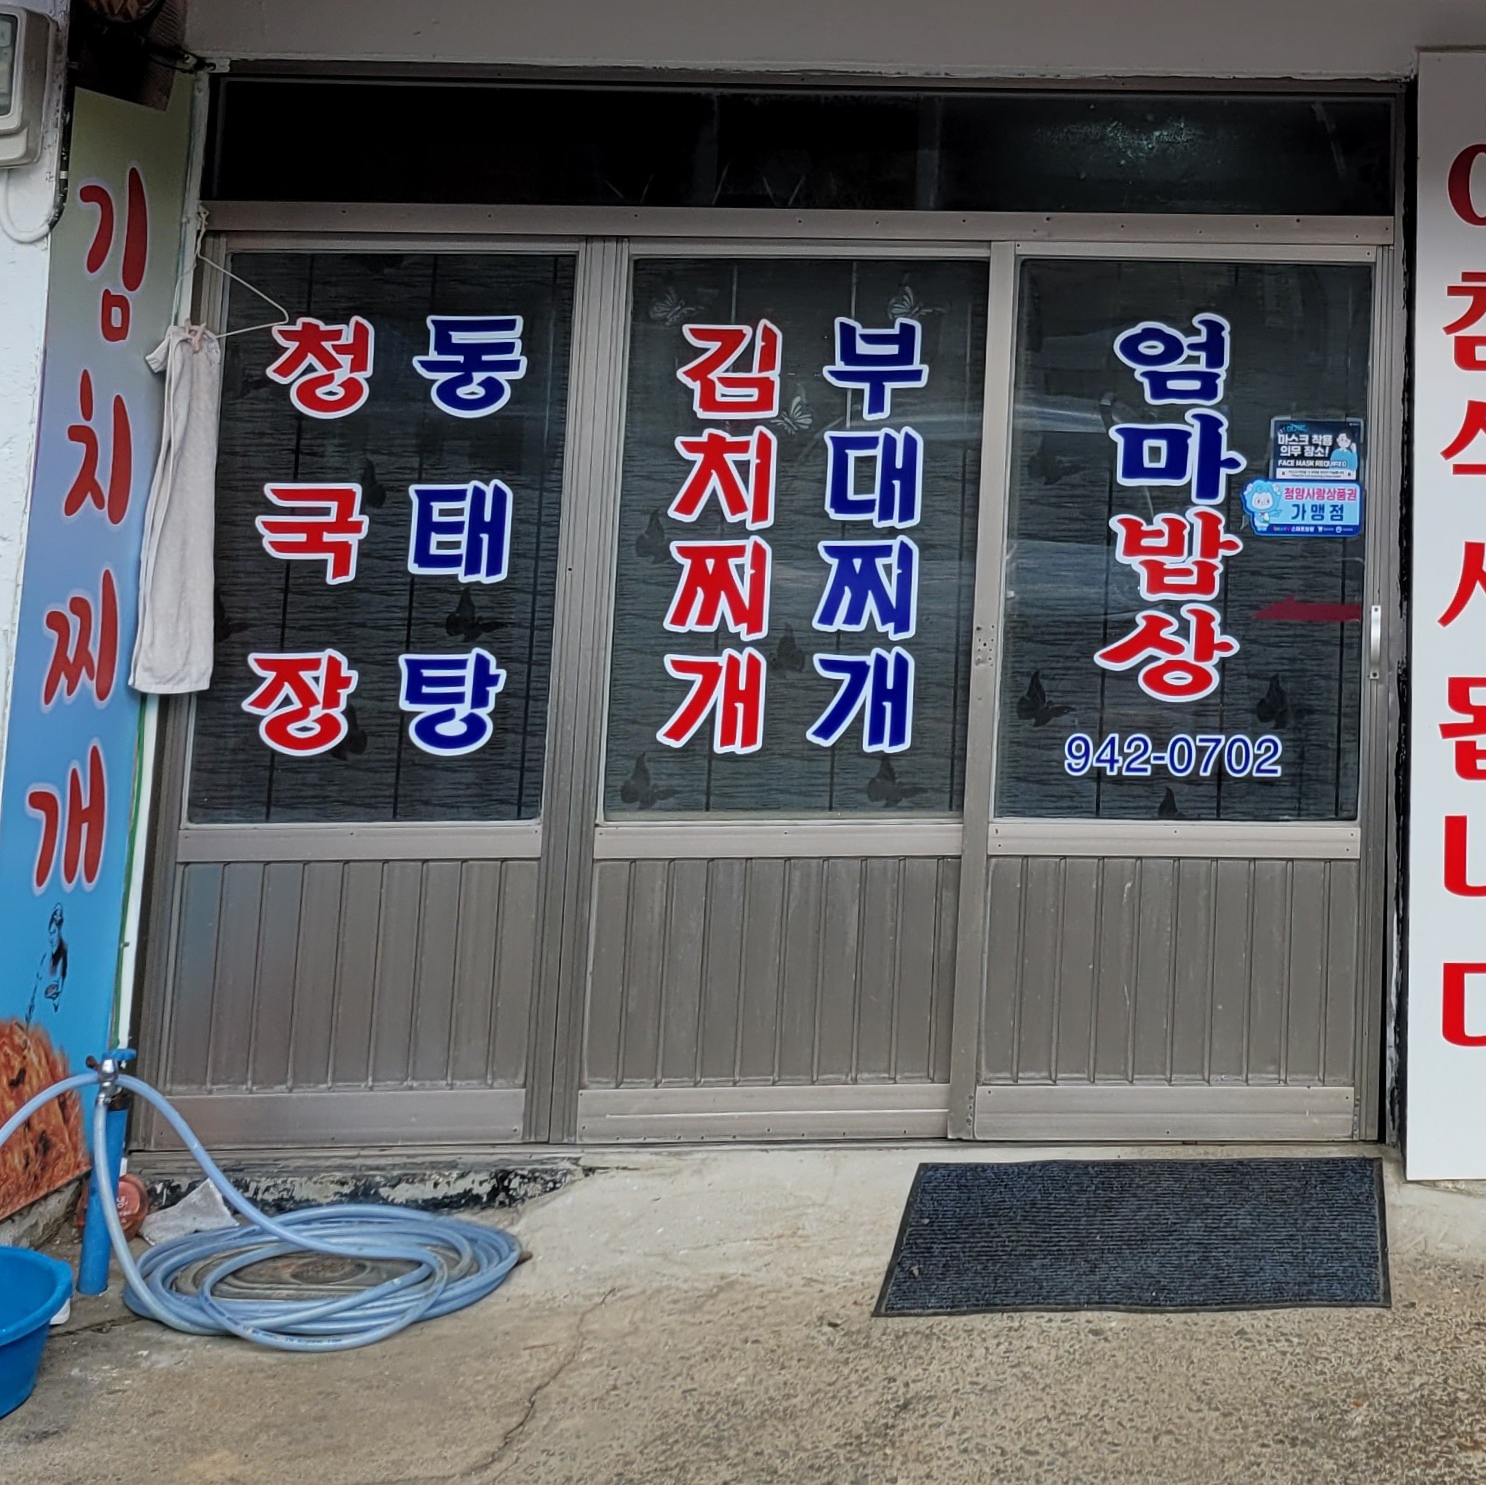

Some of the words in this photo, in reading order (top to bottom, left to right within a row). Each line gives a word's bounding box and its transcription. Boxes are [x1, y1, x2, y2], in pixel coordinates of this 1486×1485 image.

[28, 166, 149, 889] 김치찌개
[241, 315, 376, 756] 청국장
[398, 315, 528, 756] 동태탕
[656, 318, 783, 755] 김치찌개
[806, 316, 929, 753] 부대찌개
[1094, 312, 1247, 704] 엄마밥상
[1277, 433, 1309, 445] 마스크
[1278, 459, 1294, 467] FACE
[1295, 459, 1314, 467] MASK
[1280, 445, 1302, 457] 의무
[1291, 503, 1344, 521] 가맹점
[1064, 732, 1283, 778] 942-0702
